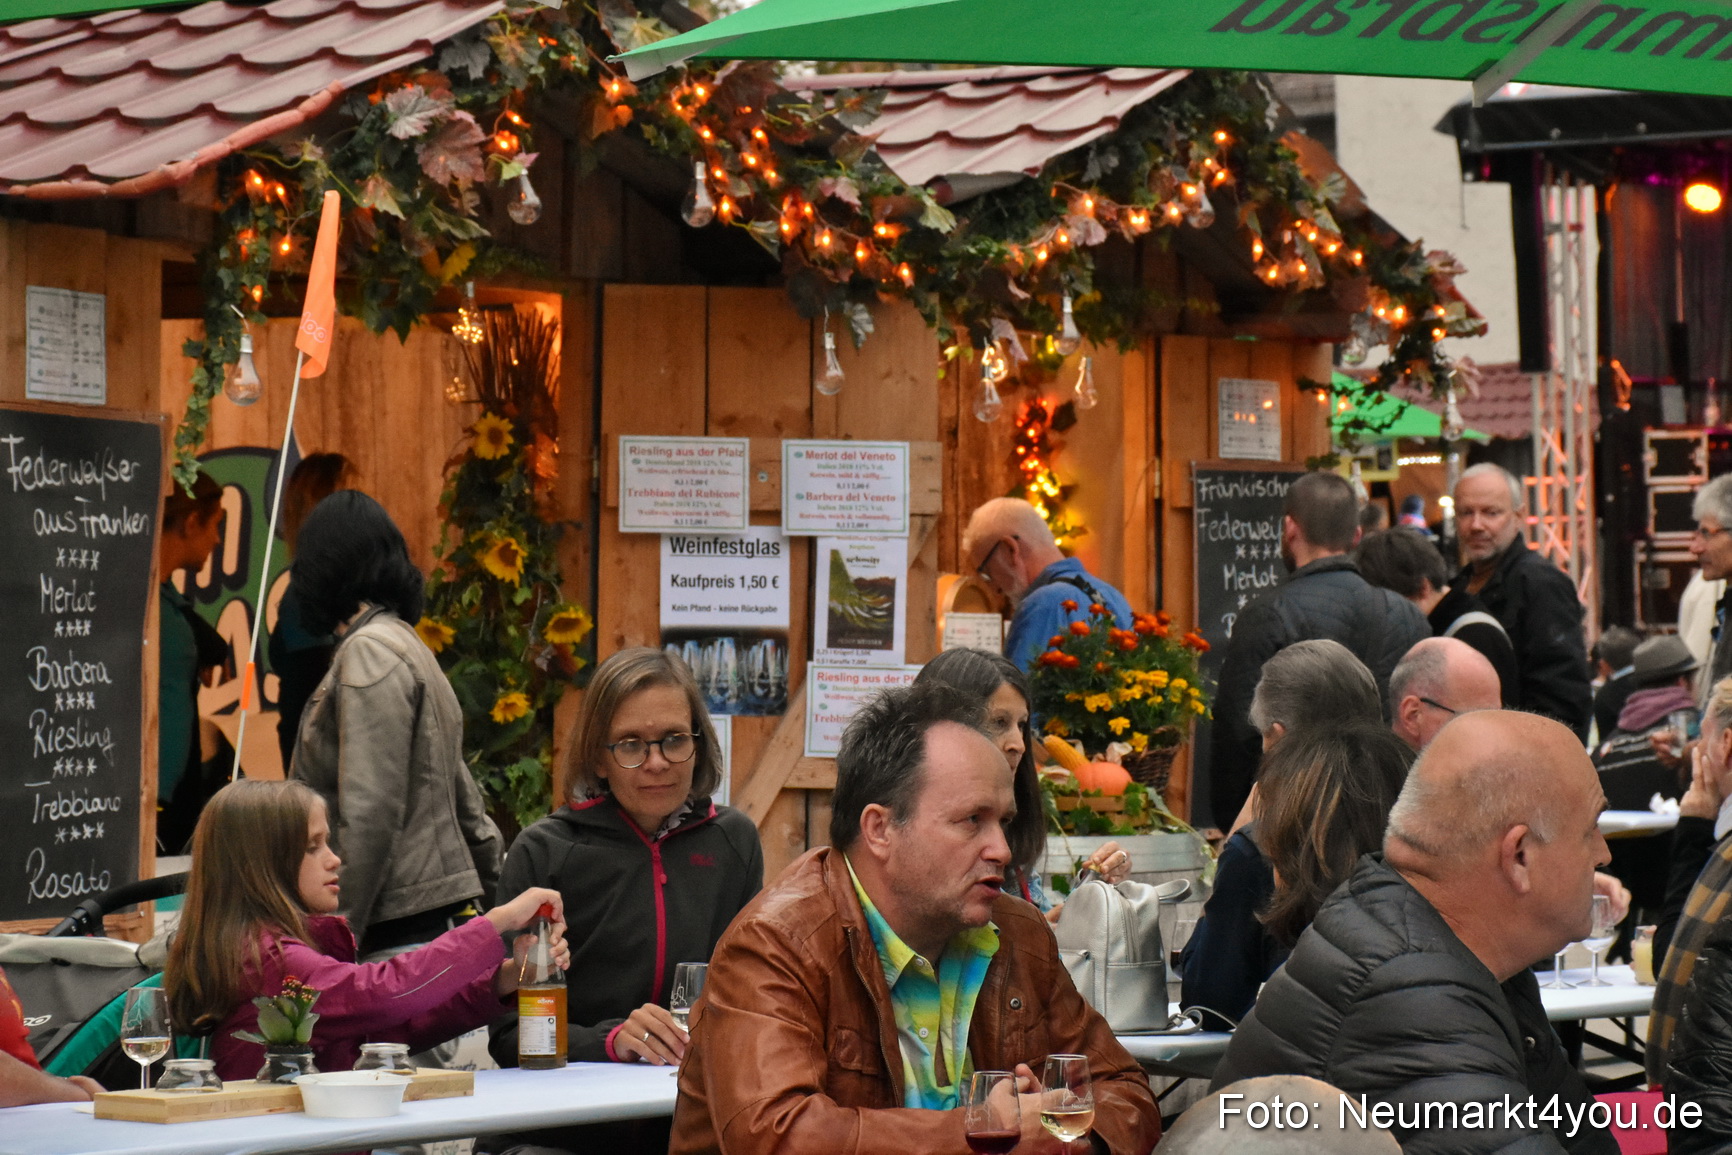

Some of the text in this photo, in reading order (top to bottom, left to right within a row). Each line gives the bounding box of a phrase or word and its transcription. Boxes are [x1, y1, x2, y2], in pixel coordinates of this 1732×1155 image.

[629, 446, 744, 458] Riesling aus der Pfalz
[805, 450, 896, 461] Merlot del Veneto
[1, 434, 141, 501] Federweißer
[628, 488, 740, 499] Trebbiano del Rubicone
[806, 492, 896, 502] Barbera del Veneto
[33, 496, 149, 539] aus Franken
[669, 536, 780, 558] Weinfestglas
[670, 574, 779, 591] Kaufpreis 1,50 €
[1223, 564, 1278, 591] Merlot
[40, 572, 97, 614] Merlot
[672, 604, 688, 612] Kein
[690, 604, 711, 612] Pfand
[719, 604, 739, 612] keine
[741, 605, 777, 614] Rückgabe
[26, 645, 112, 692] Barbera
[817, 672, 859, 684] Riesling
[862, 674, 881, 683] aus
[884, 674, 900, 683] der
[29, 708, 117, 767] Riesling
[24, 781, 121, 824] Trebbiano
[26, 847, 111, 904] Rosato
